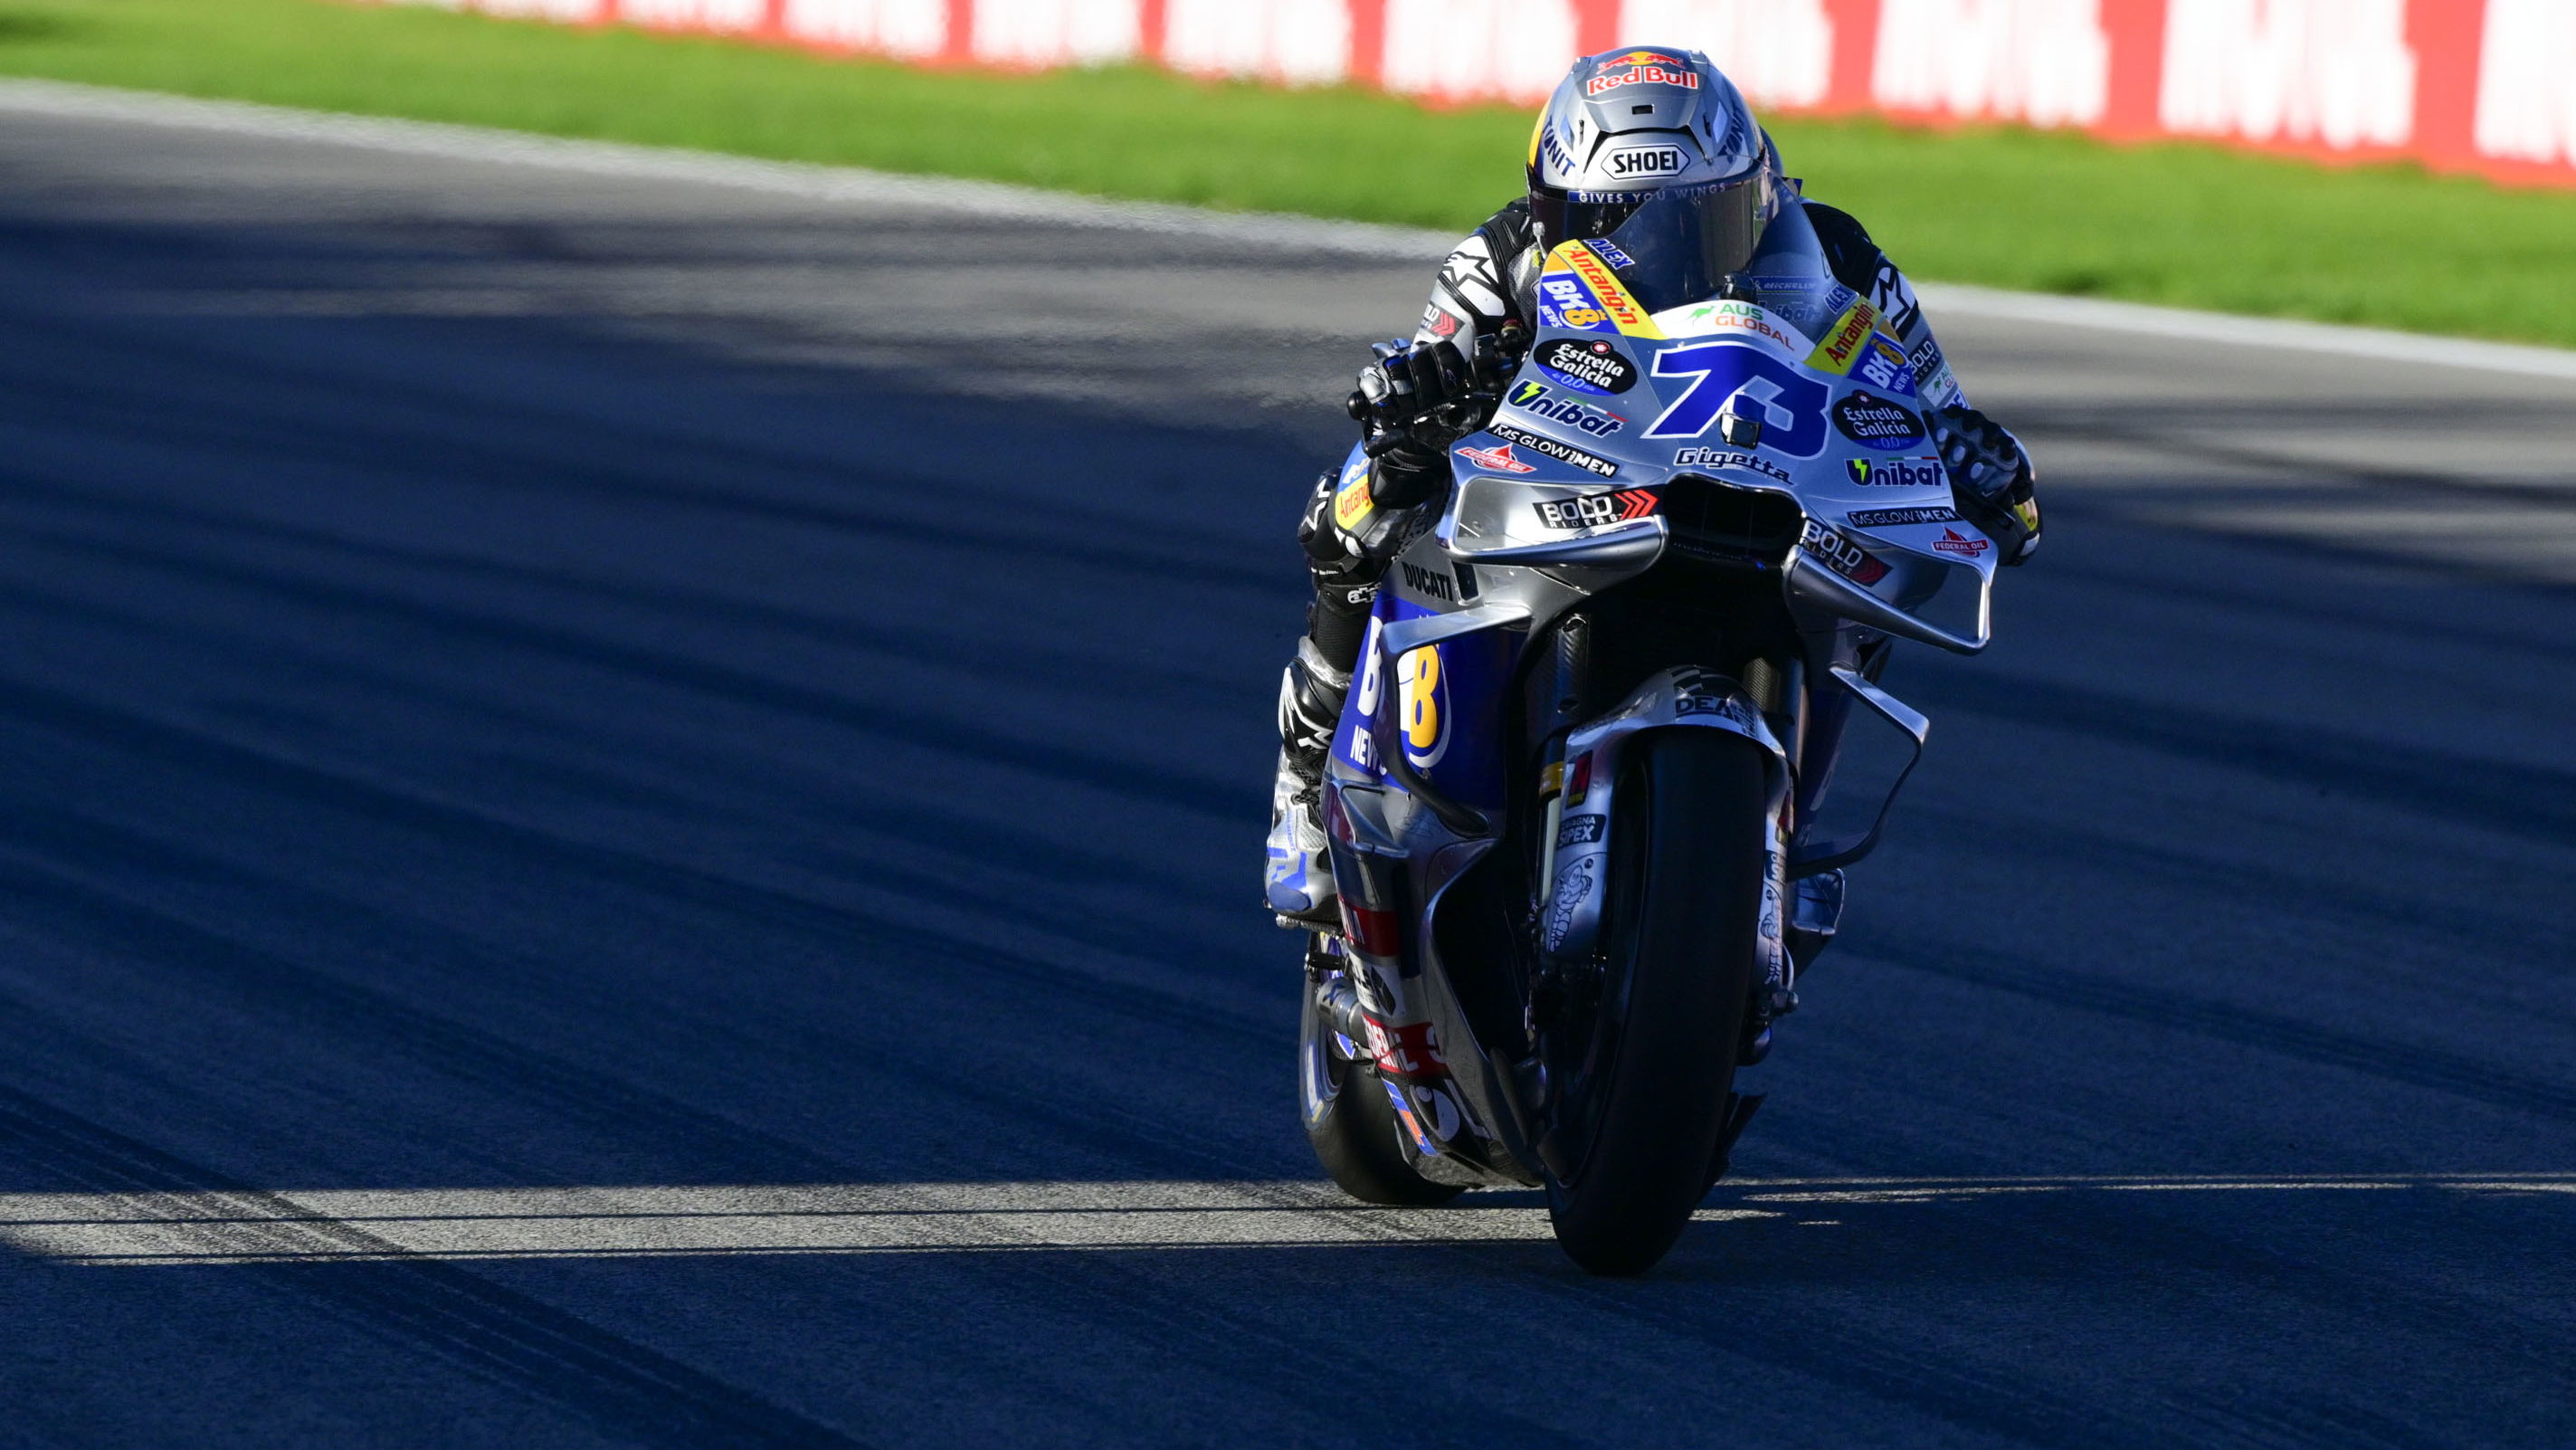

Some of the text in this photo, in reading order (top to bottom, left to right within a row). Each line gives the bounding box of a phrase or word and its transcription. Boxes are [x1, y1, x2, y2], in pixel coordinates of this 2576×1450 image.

[1587, 66, 1698, 96] Red Bull
[1614, 150, 1678, 174] SHOEI
[1578, 183, 1726, 204] GIVES YOU WINGS
[1584, 239, 1634, 270] ALEX
[1564, 250, 1639, 324] Antangin
[1825, 284, 1855, 313] ALEX
[1539, 305, 1563, 328] NEWS
[1542, 280, 1603, 329] BK8
[1719, 303, 1763, 320] AUS
[1716, 315, 1795, 351] GLOBAL
[1825, 302, 1876, 367] Antangin
[1550, 355, 1612, 387] Galicia
[1554, 343, 1624, 377] Estrella
[1862, 339, 1906, 389] BK8
[1894, 372, 1910, 393] NEWS
[1508, 380, 1622, 436] Unibat
[1843, 407, 1905, 421] Estrella
[1853, 422, 1911, 436] Galicia
[1494, 424, 1520, 441] MS
[1519, 434, 1570, 458] GLOW
[1573, 452, 1616, 477] MEN
[1676, 448, 1794, 486] Gigetta
[1846, 459, 1943, 486] Unibat
[1542, 496, 1612, 522] BOLD
[1550, 513, 1618, 529] RIDERS
[1853, 510, 1954, 526] MS GLOW MEN
[1806, 521, 1863, 568] BOLD
[1934, 541, 1985, 550] FEDERAL OIL
[1402, 561, 1453, 602] DUCATI
